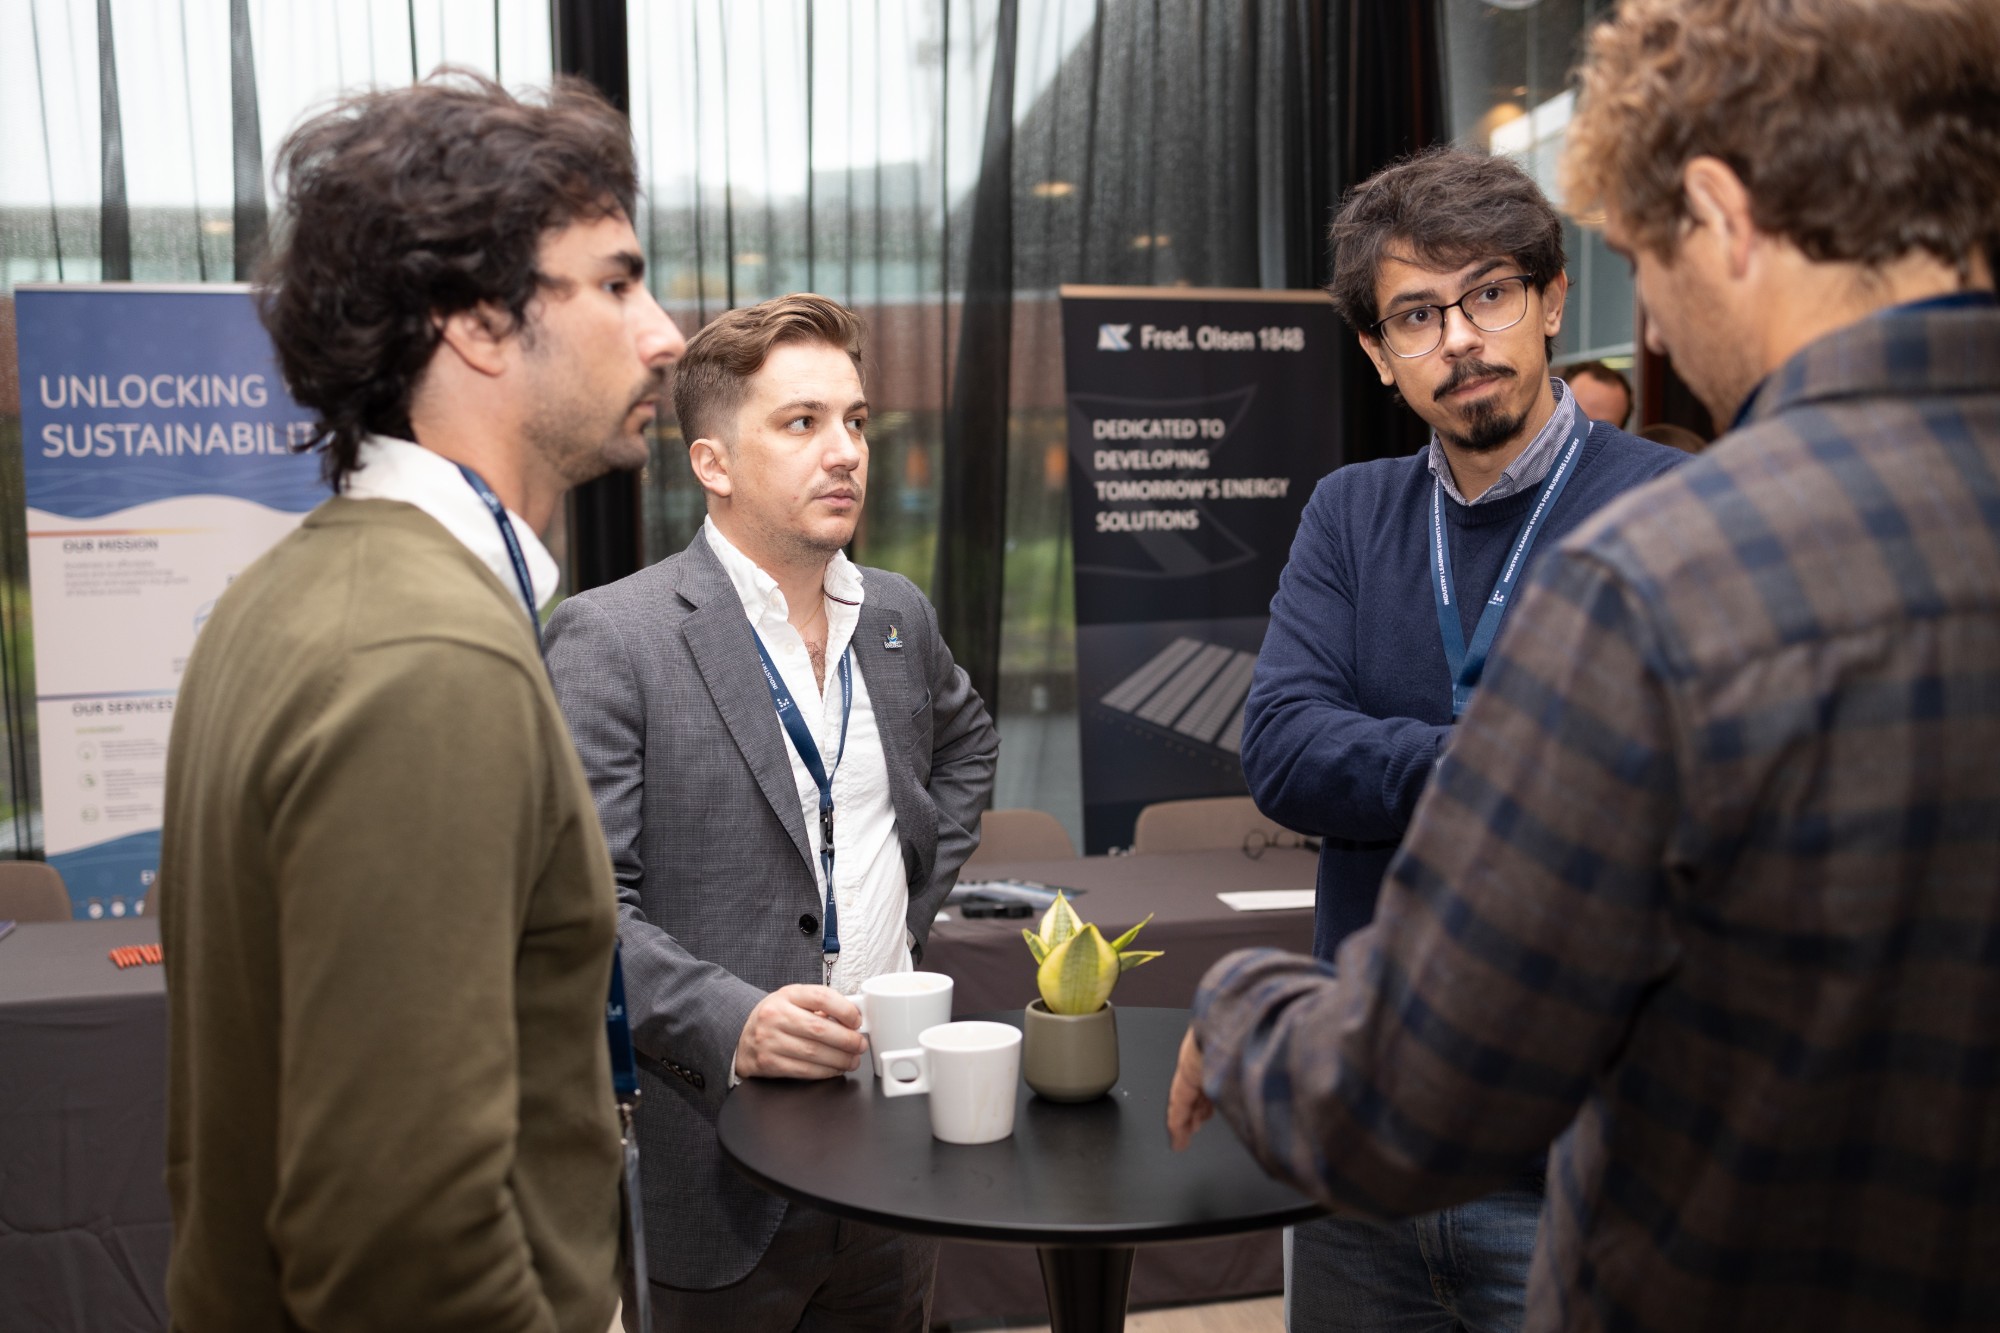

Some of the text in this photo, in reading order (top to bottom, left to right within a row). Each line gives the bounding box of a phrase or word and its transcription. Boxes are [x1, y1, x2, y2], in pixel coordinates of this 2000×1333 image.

[1140, 324, 1304, 352] Fred. Olsen 1848
[40, 374, 268, 409] UNLOCKING
[41, 422, 335, 458] SUSTAINABILIT
[1093, 418, 1225, 440] DEDICATED TO
[1094, 449, 1210, 470] DEVELOPING
[1095, 478, 1290, 501] TOMORROW'S ENERGY
[1096, 510, 1199, 532] SOLUTIONS
[1503, 437, 1580, 583] INDUSTRY LEADING EVENTS FOR BUSINESS LEADERS
[1437, 548, 1445, 575] LEADING
[1440, 575, 1450, 606] INDUSTRY
